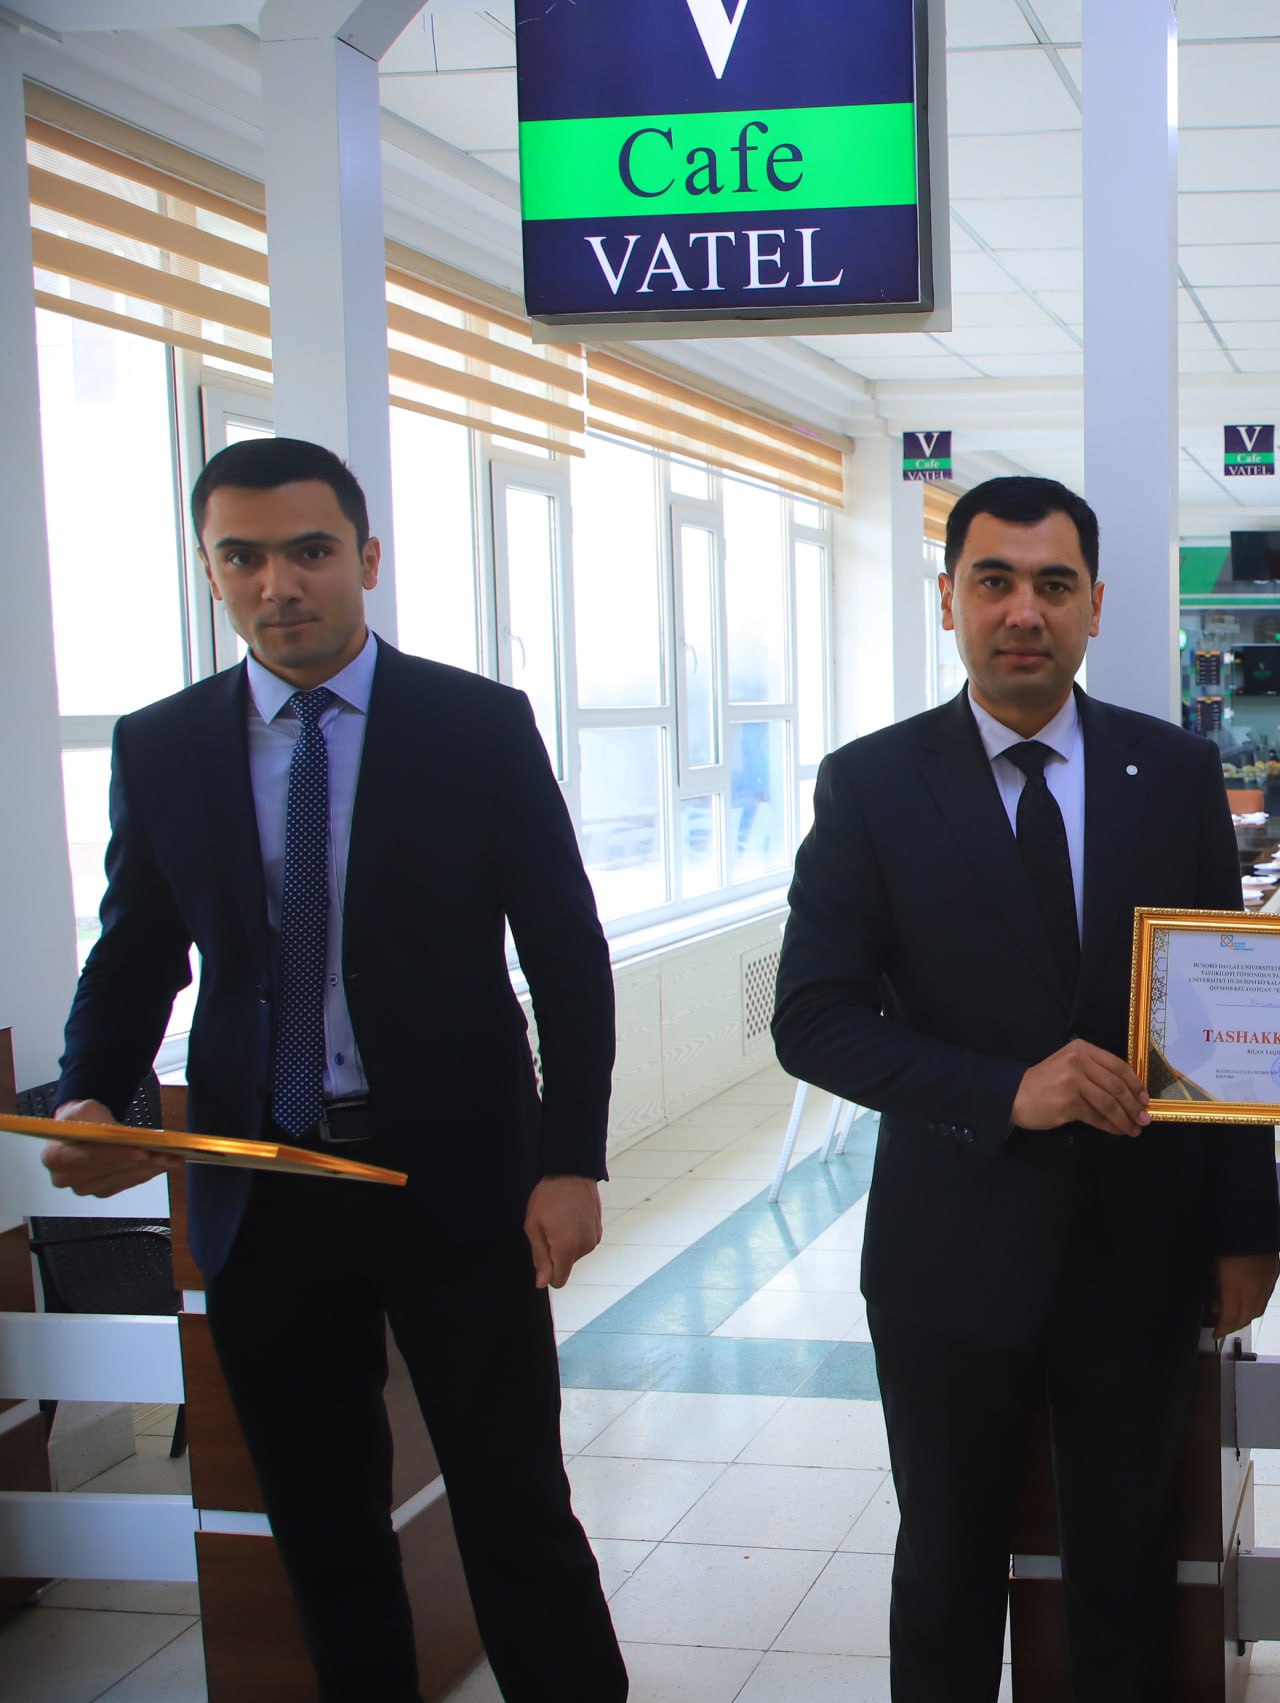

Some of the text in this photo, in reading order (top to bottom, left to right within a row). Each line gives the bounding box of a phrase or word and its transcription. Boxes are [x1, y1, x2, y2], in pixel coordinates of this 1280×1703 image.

[618, 121, 804, 198] Cafe
[584, 227, 844, 296] VATEL
[914, 432, 940, 458] V
[1236, 426, 1263, 452] V
[915, 459, 940, 469] Cafe
[1236, 453, 1262, 463] Cafe
